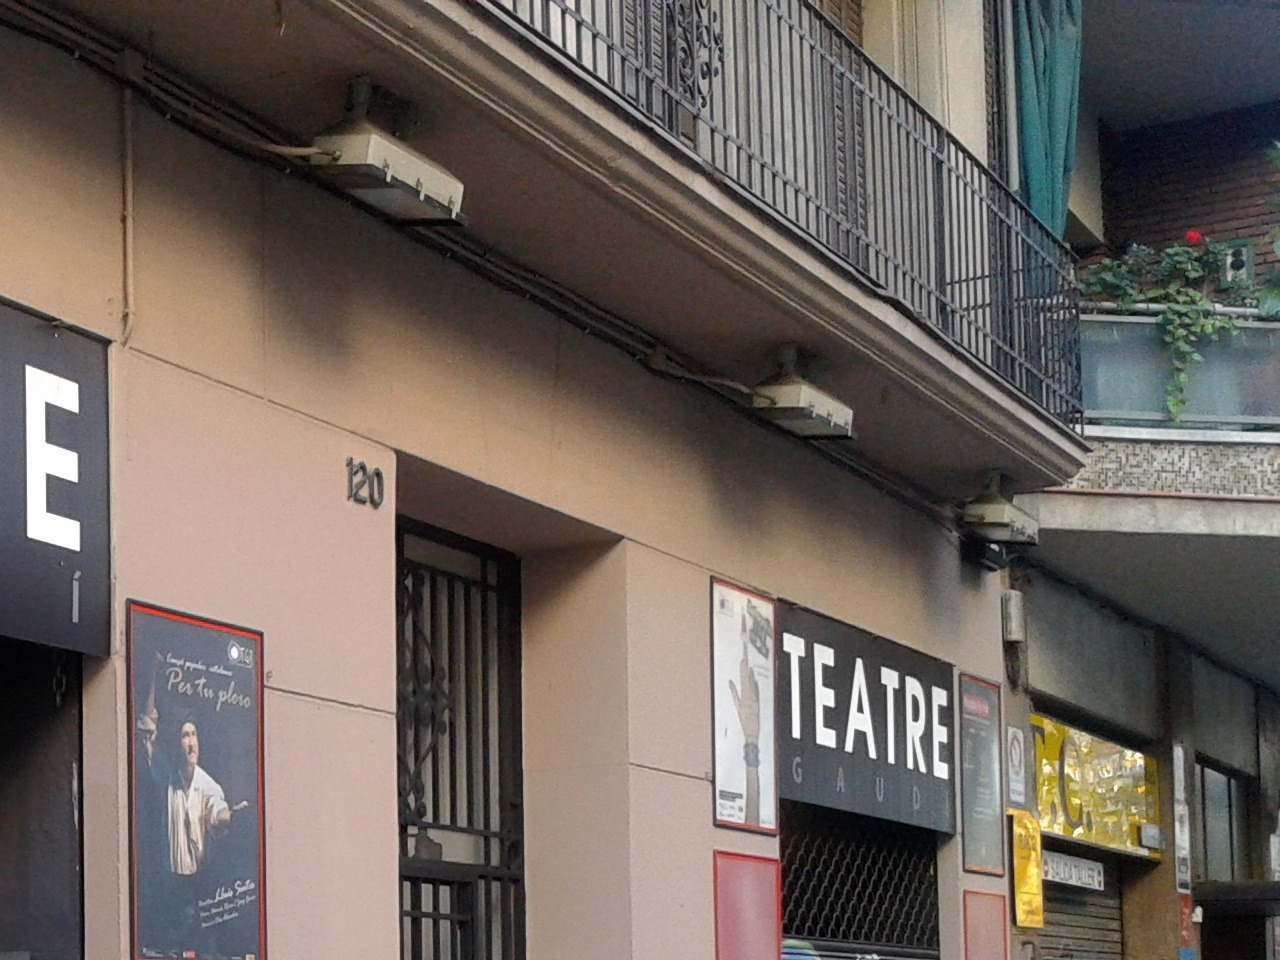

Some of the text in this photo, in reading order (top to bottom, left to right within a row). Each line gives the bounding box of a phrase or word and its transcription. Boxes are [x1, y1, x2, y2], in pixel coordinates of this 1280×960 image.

[345, 455, 384, 510] 120
[165, 666, 194, 696] Per
[216, 680, 251, 712] ploro
[782, 631, 950, 780] TEATRE
